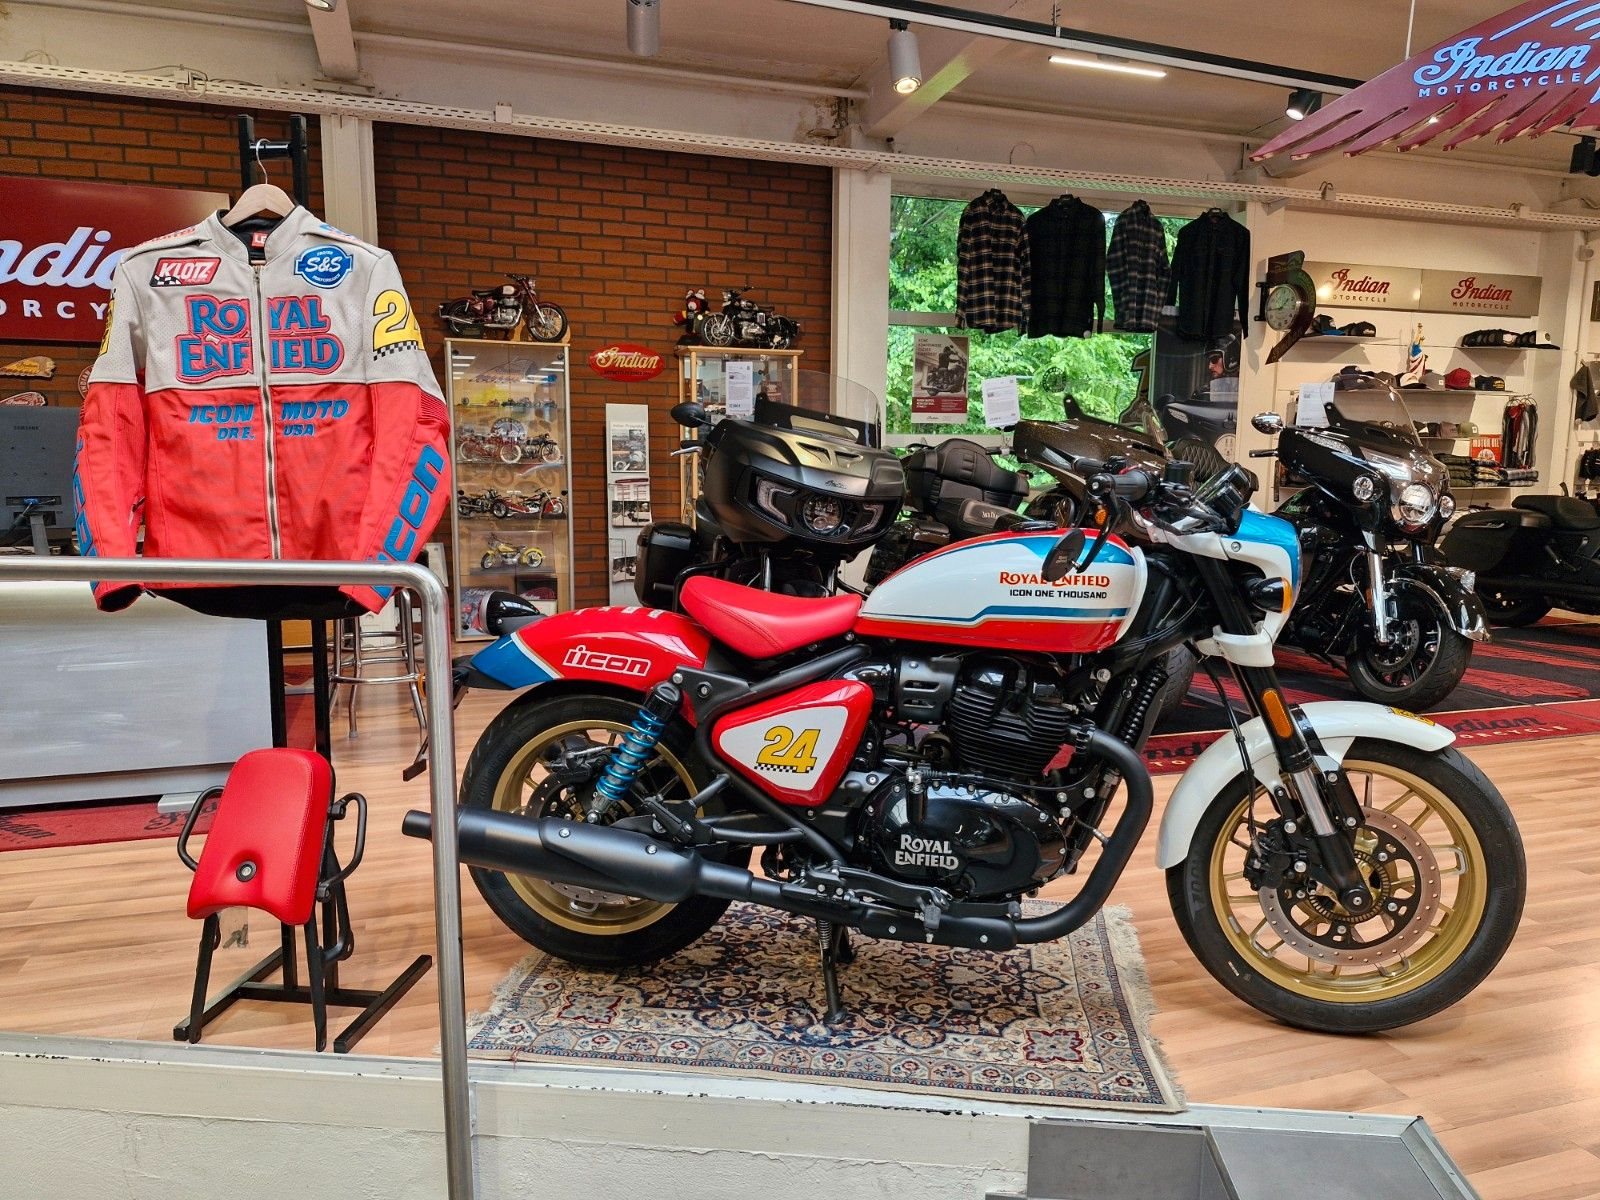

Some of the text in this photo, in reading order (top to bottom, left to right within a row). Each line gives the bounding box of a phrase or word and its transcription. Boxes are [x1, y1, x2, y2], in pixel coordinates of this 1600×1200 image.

[1413, 37, 1592, 86] Indian
[1418, 72, 1582, 98] MOTORCYCLE
[159, 261, 215, 281] KLOTZ
[304, 256, 343, 273] S&S
[1330, 268, 1391, 294] Indian
[1450, 276, 1513, 302] Indian
[1332, 294, 1387, 303] OTORCYCLE
[1452, 301, 1510, 310] MOTORCYCLE
[189, 298, 328, 336] ROYAL
[179, 337, 341, 378] ENFIELD
[595, 346, 660, 369] Indian
[188, 399, 351, 424] ICON MOTO
[283, 423, 316, 437] USA
[1010, 589, 1108, 599] ICON ONE THOUSAND
[1453, 717, 1548, 733] dian
[1459, 724, 1568, 740] ORCYCLE
[756, 725, 822, 773] 24
[900, 833, 953, 854] ROYAL
[894, 850, 959, 871] ENFIELD
